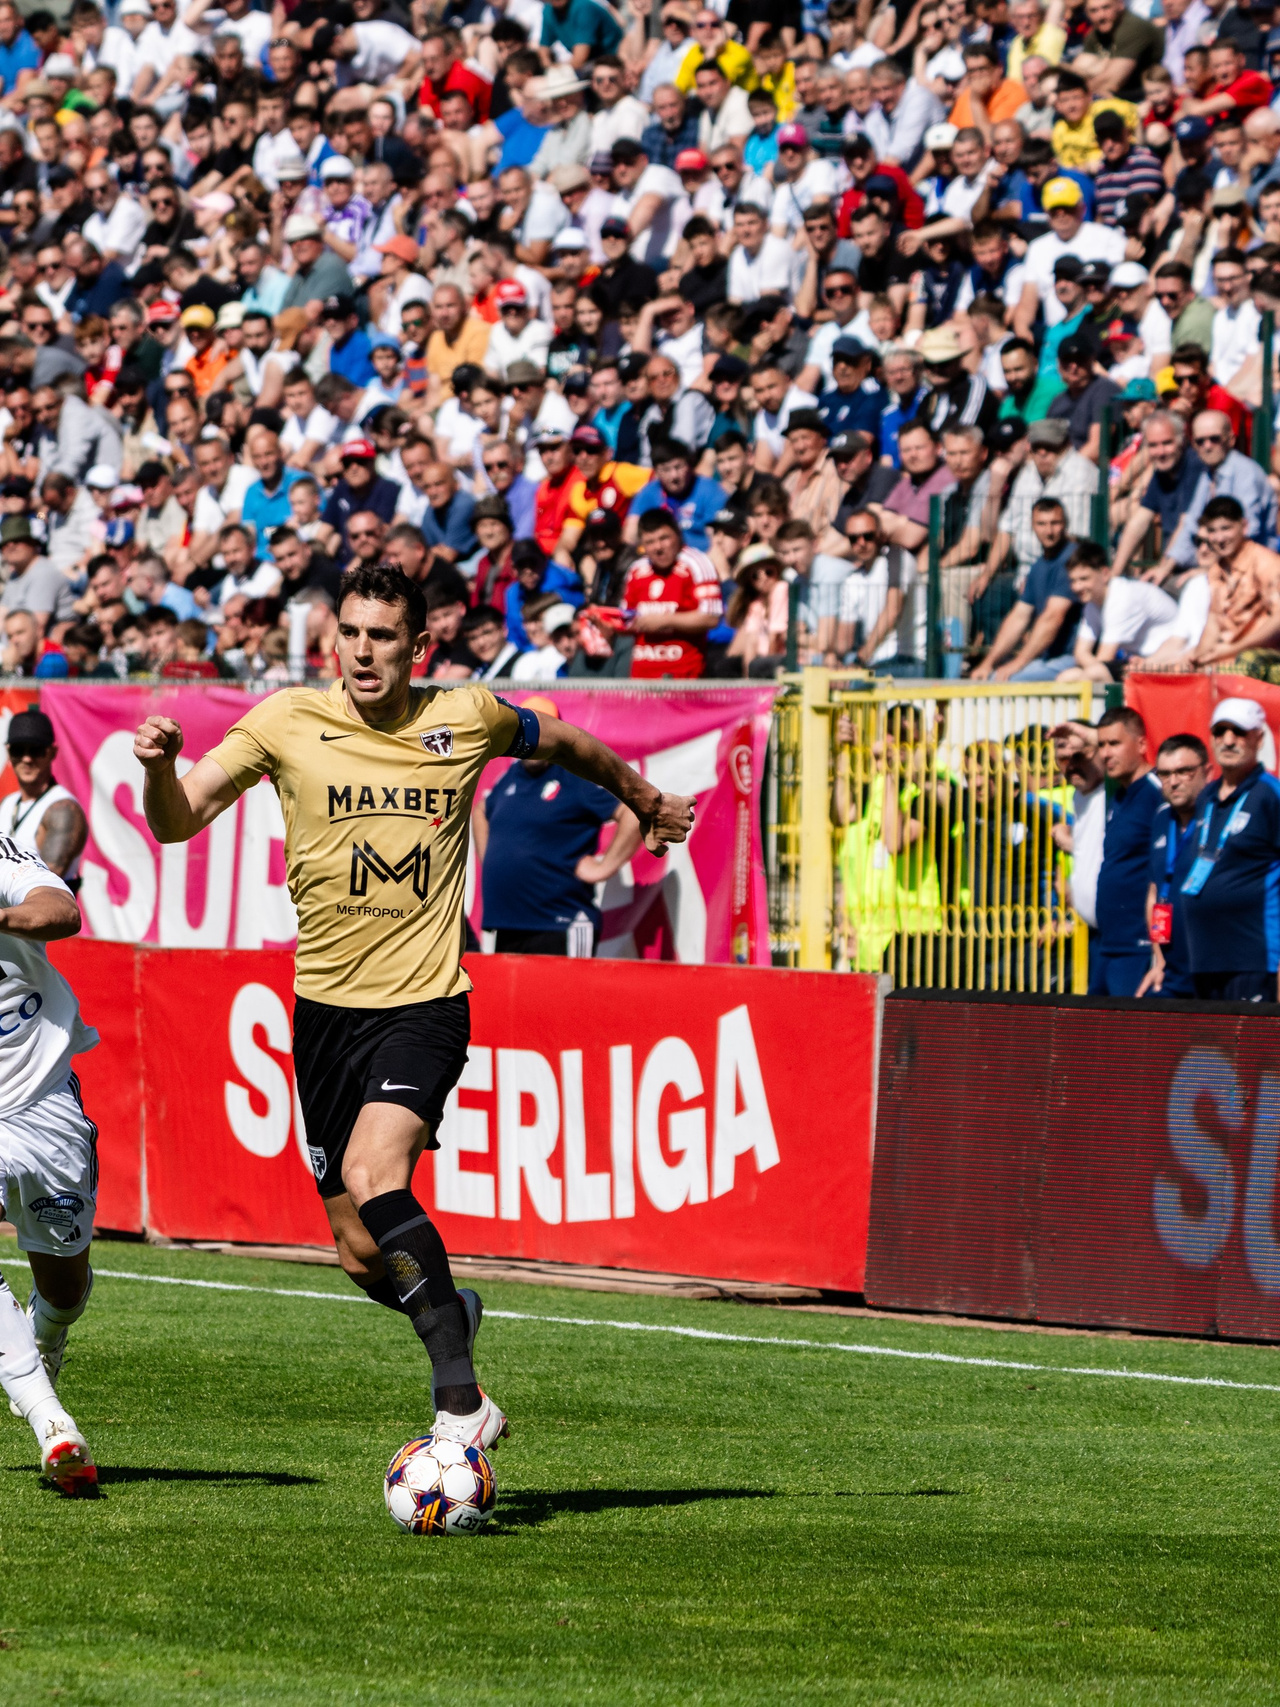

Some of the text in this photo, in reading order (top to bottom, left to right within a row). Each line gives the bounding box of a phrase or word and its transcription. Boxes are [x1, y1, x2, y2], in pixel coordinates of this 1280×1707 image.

[327, 785, 457, 819] MAXBET
[225, 982, 780, 1225] SERLIGA
[31, 1198, 48, 1210] FIVE
